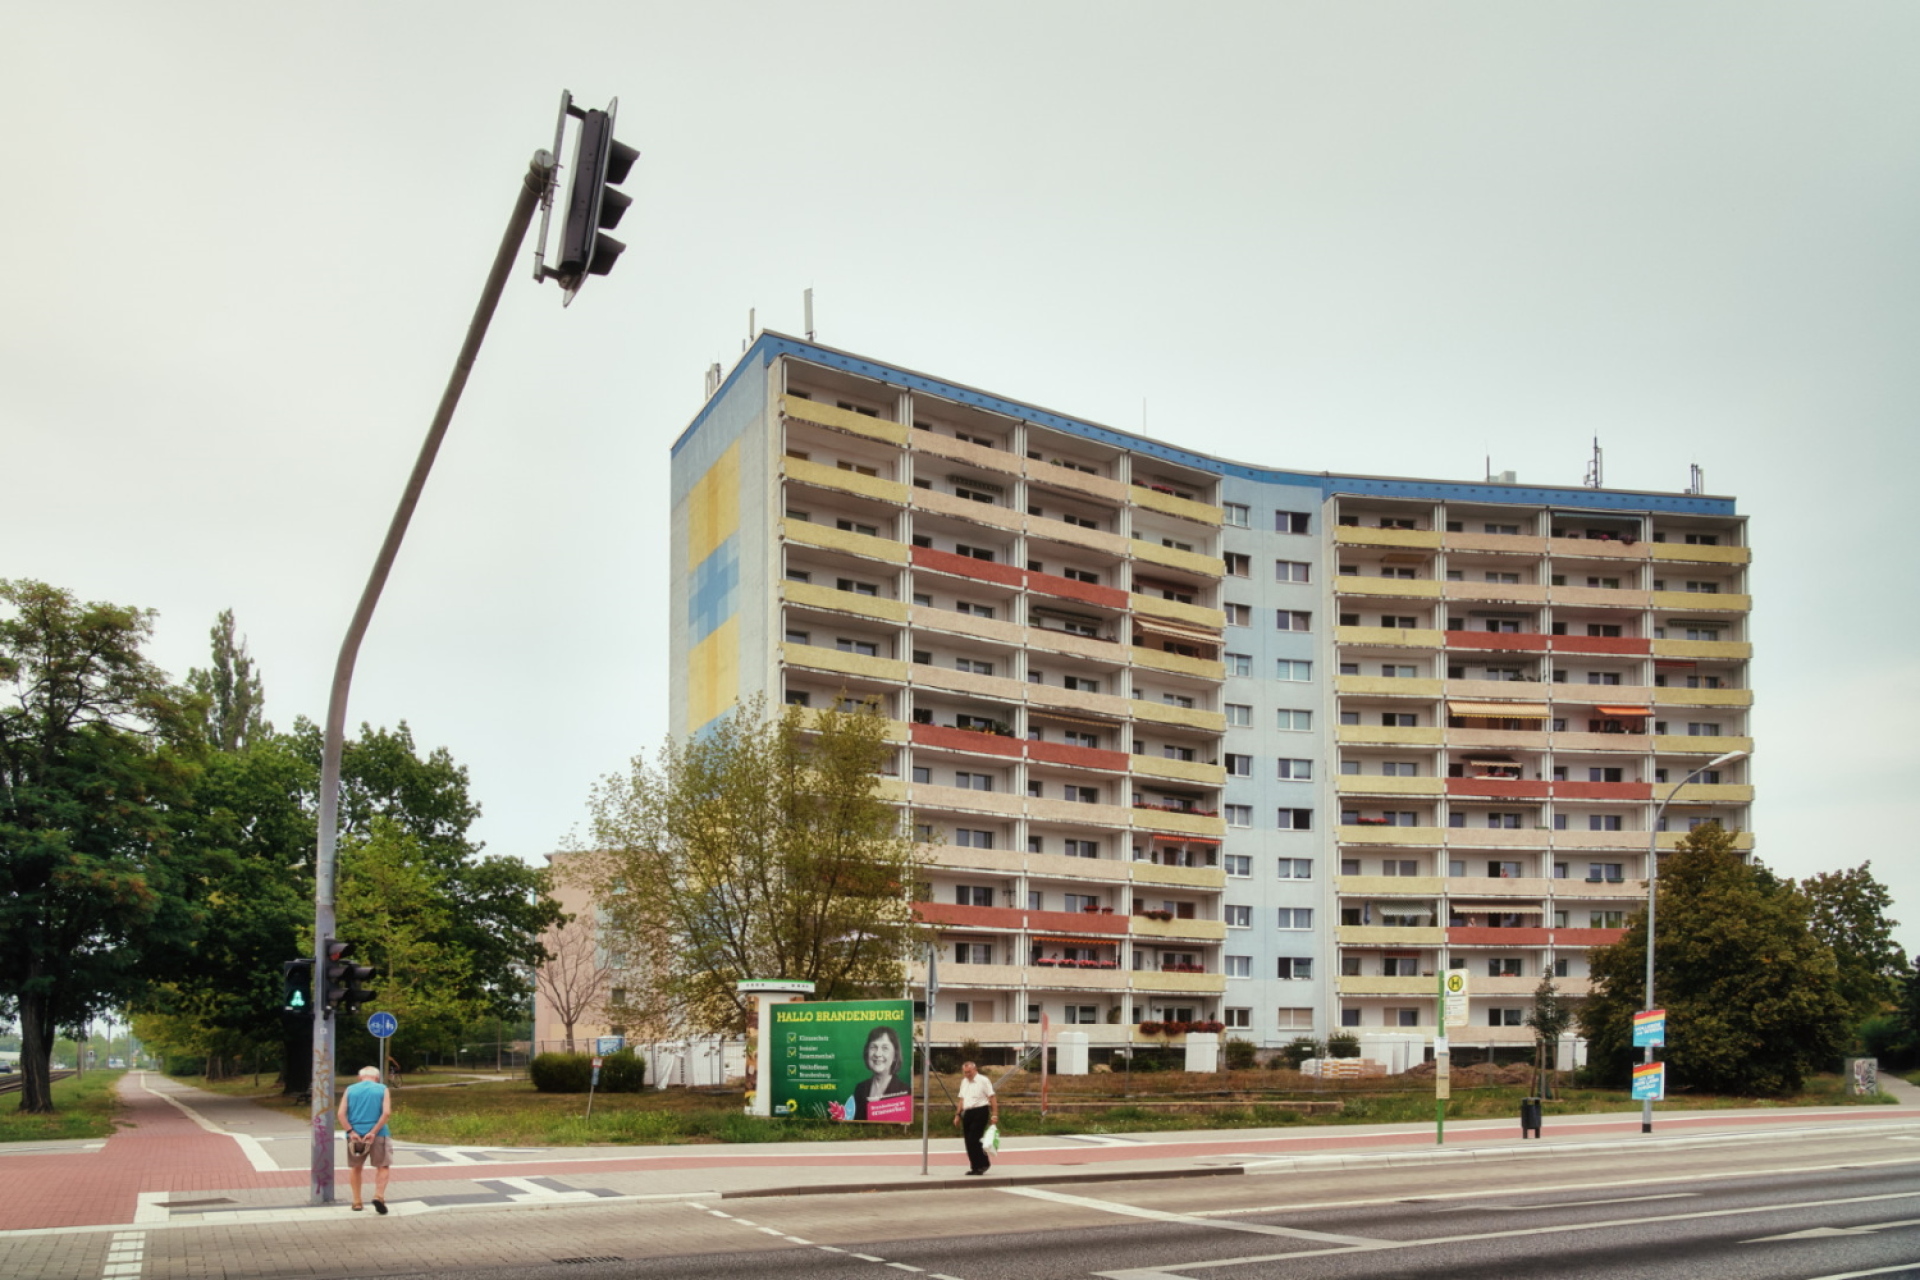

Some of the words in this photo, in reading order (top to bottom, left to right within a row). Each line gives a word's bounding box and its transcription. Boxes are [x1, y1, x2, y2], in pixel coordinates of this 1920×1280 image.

[1451, 978, 1460, 989] H
[777, 1011, 814, 1023] HALLO
[816, 1009, 905, 1022] BRANDENBURG!
